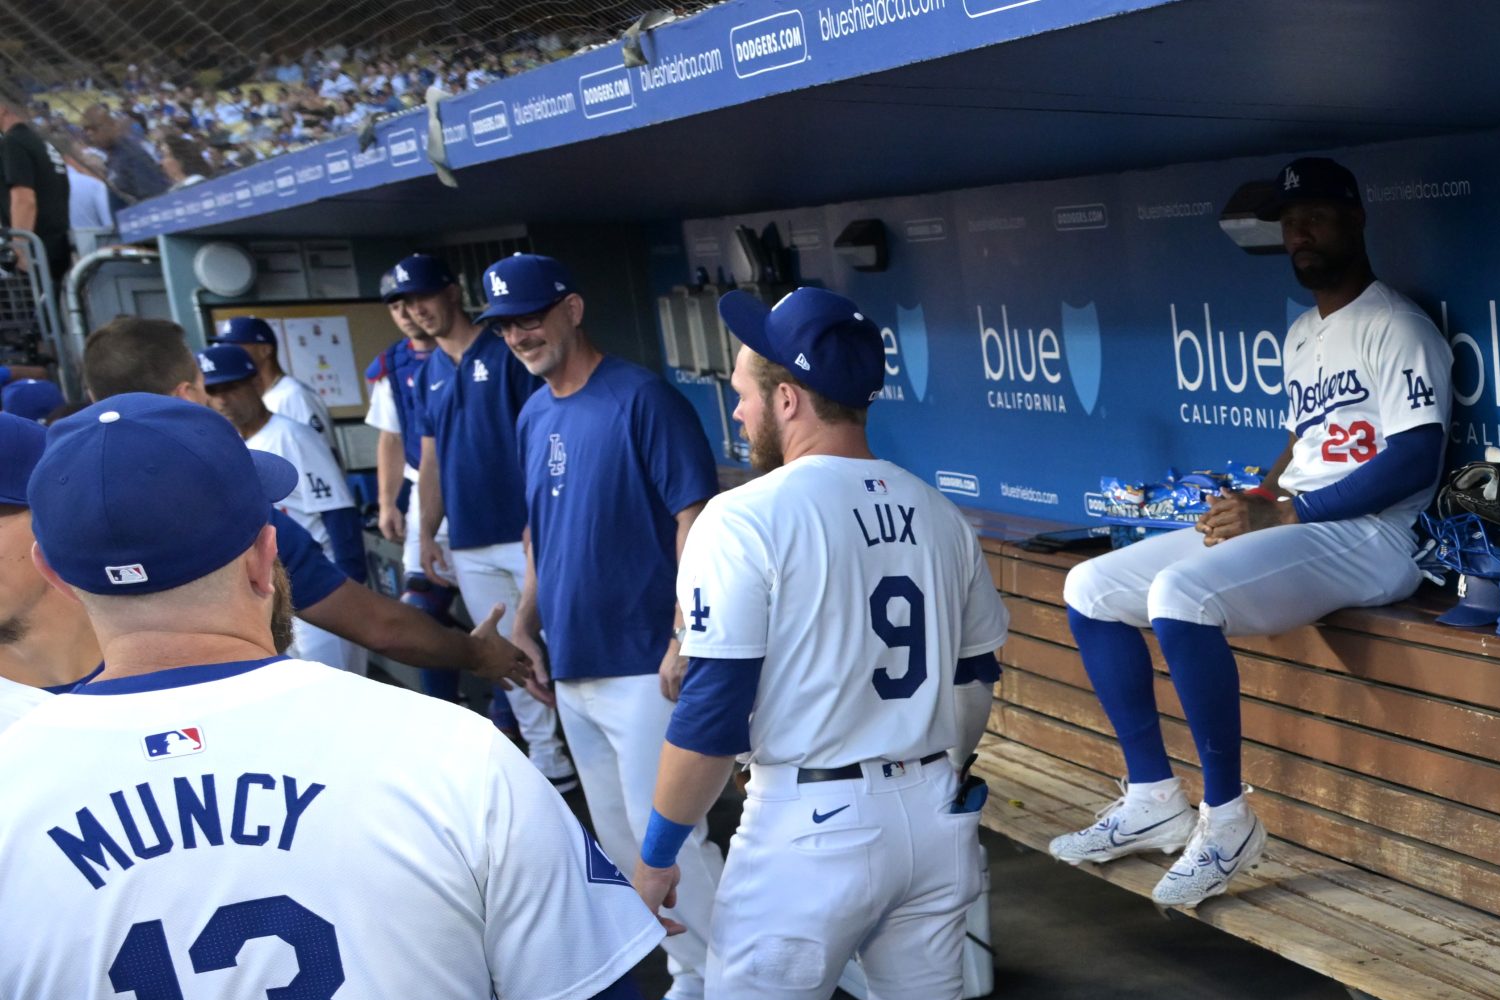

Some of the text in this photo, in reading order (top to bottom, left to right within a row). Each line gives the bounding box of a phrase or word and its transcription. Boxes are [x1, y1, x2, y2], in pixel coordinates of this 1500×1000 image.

[736, 27, 802, 62] DODGERS.COM
[639, 48, 723, 91] blueshieldca.com
[583, 78, 630, 105] DODGERS.COM
[1366, 178, 1471, 203] blueshieldca.com
[489, 270, 509, 297] LA
[977, 304, 1062, 383] blue
[1170, 302, 1282, 395] blue
[473, 359, 488, 382] LA
[1402, 368, 1436, 410] LA
[988, 390, 1067, 414] CALIFORNIA
[1180, 403, 1288, 430] CALIFORNIA
[1289, 366, 1370, 430] Dodgers
[1321, 420, 1378, 464] 23
[306, 472, 333, 499] LA
[853, 504, 917, 547] LUX
[869, 575, 928, 701] 9
[47, 772, 327, 889] MUNCY
